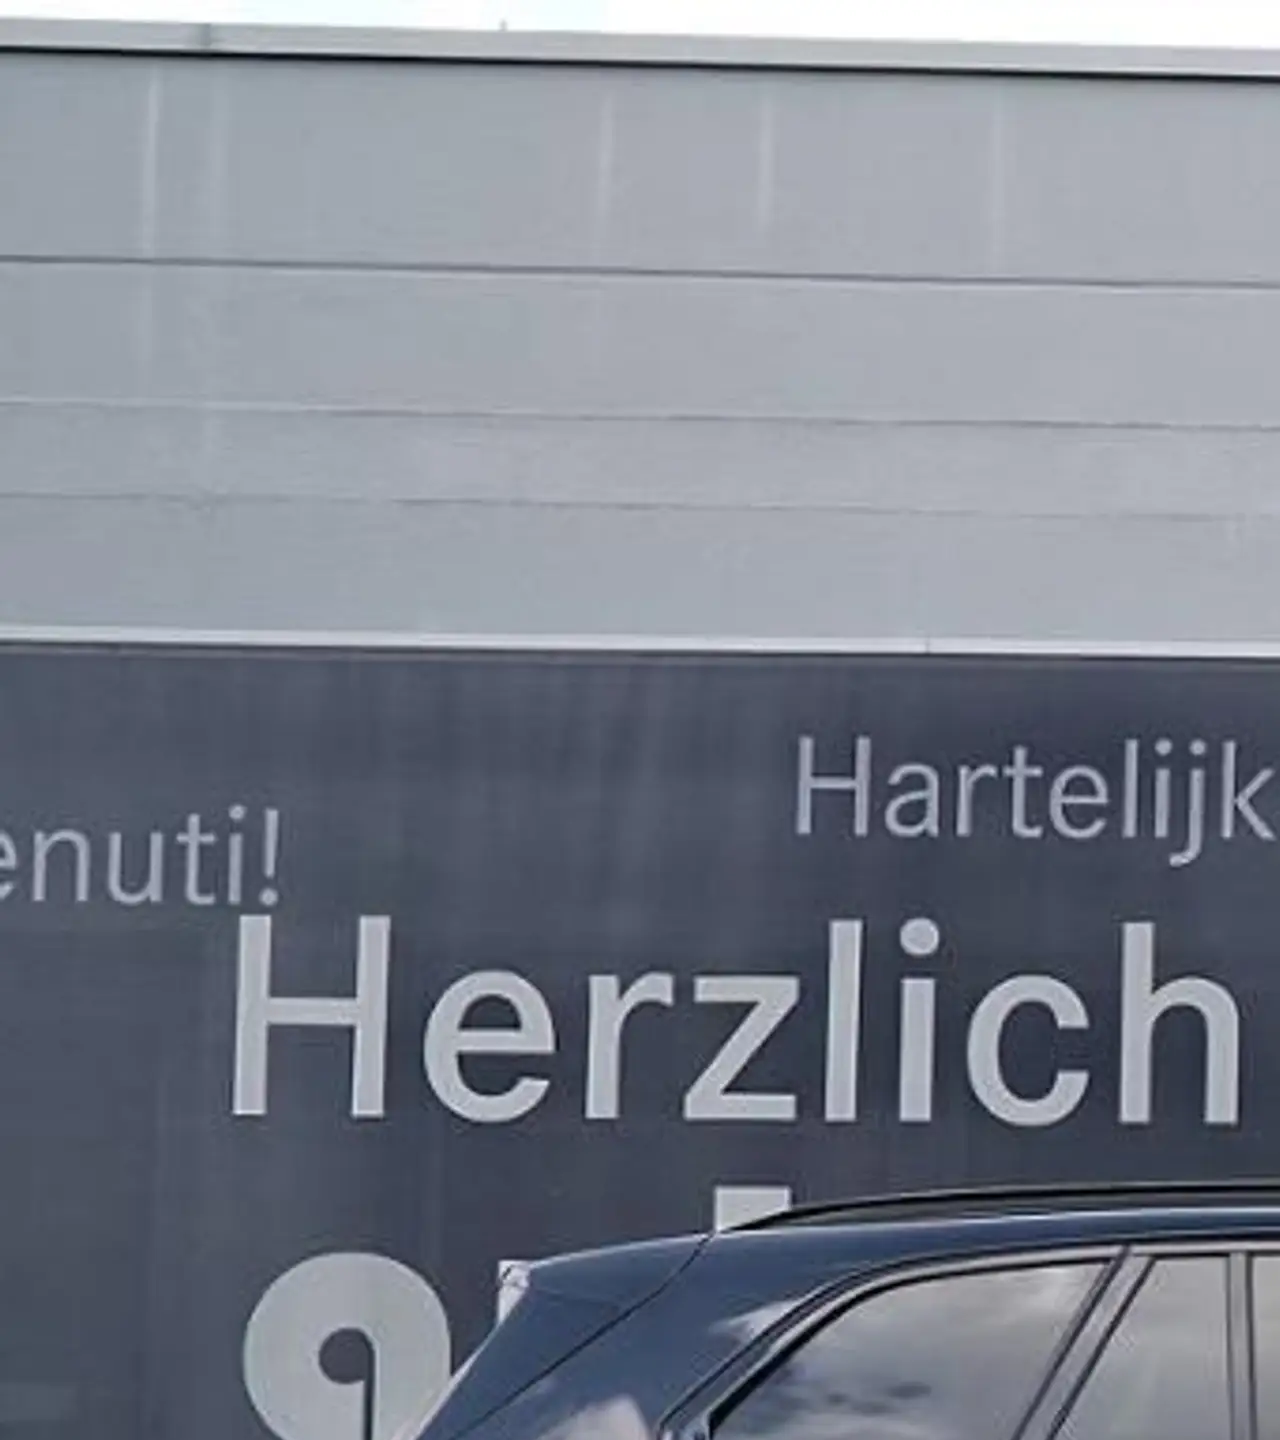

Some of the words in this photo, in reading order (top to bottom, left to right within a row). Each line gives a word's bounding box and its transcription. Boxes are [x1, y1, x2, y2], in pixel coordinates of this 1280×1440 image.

[0, 804, 280, 907] nuti!
[796, 735, 1275, 867] Hartelijk
[231, 913, 1240, 1127] Herzlich
